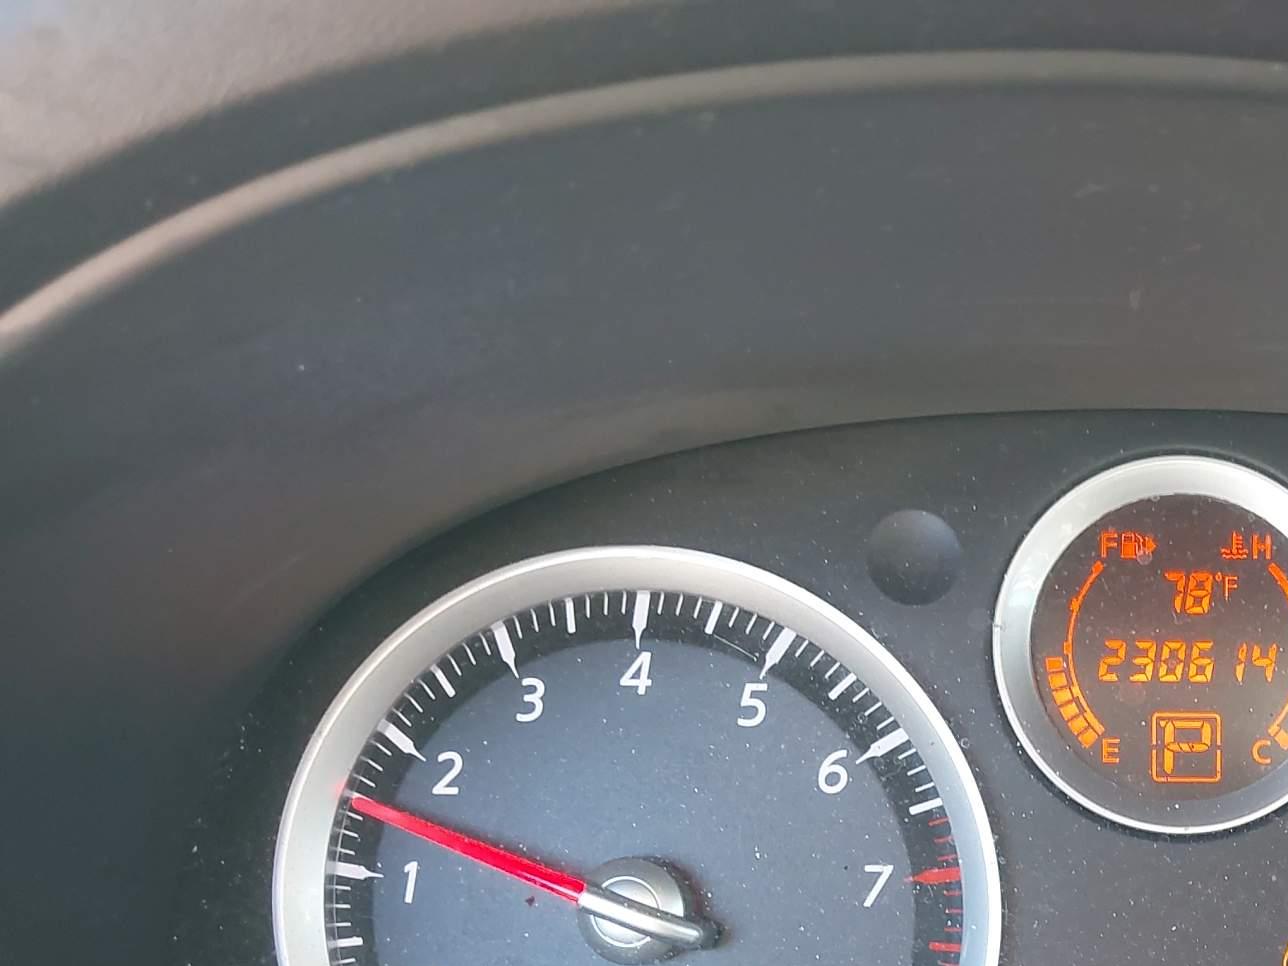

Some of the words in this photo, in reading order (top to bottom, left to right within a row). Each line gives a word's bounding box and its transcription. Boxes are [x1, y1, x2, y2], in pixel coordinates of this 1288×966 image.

[1101, 532, 1119, 558] F
[1250, 534, 1272, 560] H
[619, 651, 652, 696] 4
[1098, 639, 1278, 683] 230614
[515, 677, 545, 722] 3
[737, 682, 768, 727] 5
[1101, 737, 1119, 764] E
[1158, 719, 1212, 774] P
[1250, 737, 1271, 765] C
[431, 751, 463, 795] 2
[817, 749, 848, 794] 6
[403, 860, 419, 904] 1
[863, 864, 893, 908] 7
